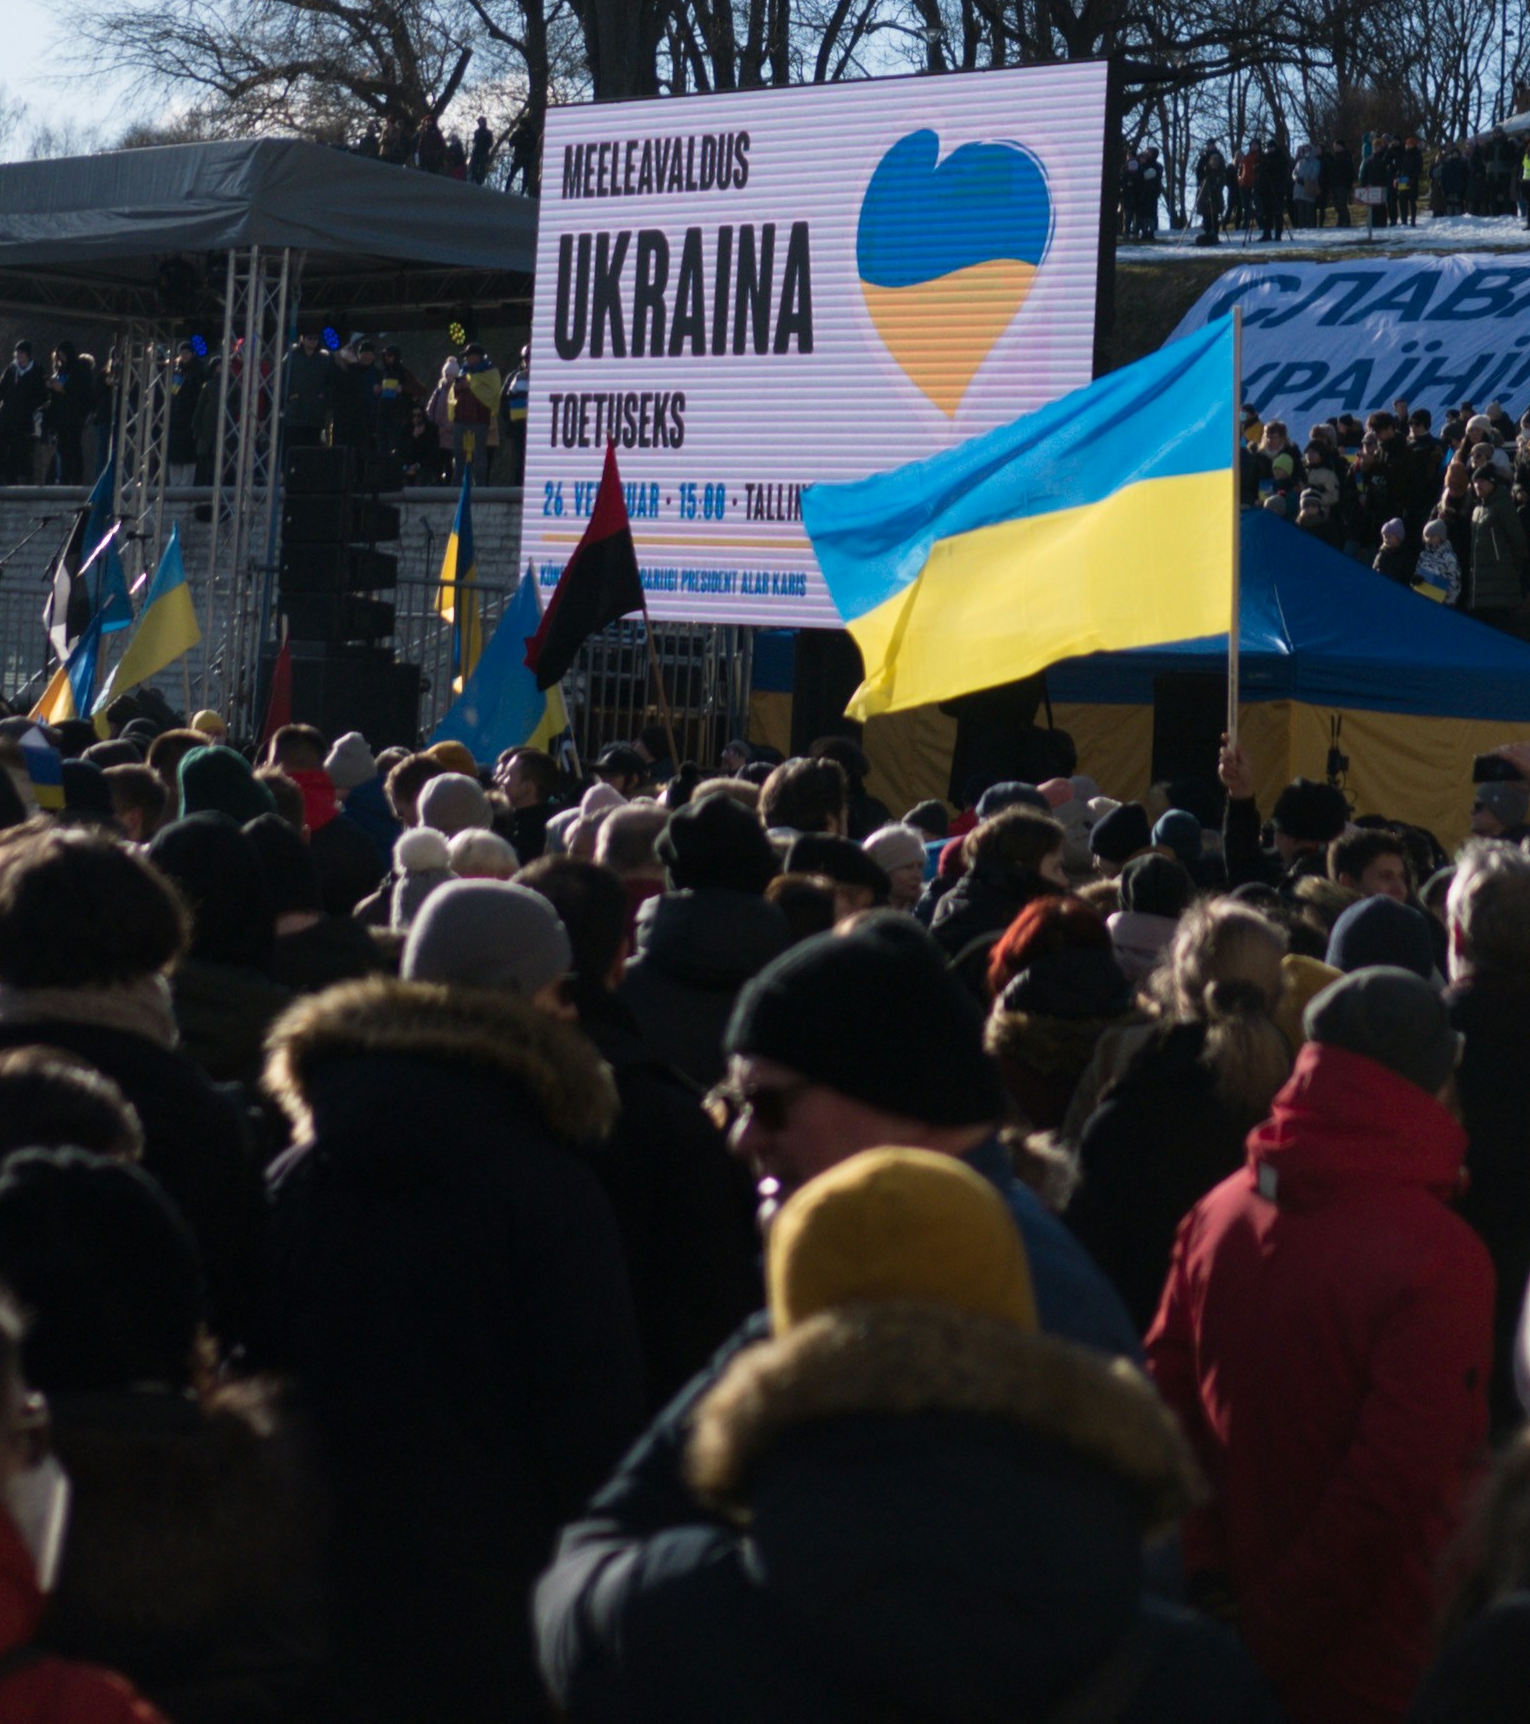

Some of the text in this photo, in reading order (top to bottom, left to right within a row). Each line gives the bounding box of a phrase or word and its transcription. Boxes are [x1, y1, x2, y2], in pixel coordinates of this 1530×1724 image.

[562, 131, 751, 199] MEELEAVALDUS
[553, 220, 814, 361] UKRAINA
[549, 389, 686, 449] TOETUSEKS
[543, 480, 568, 516] 26.
[572, 481, 660, 518] VEUAR
[679, 482, 726, 520] 15:00
[681, 569, 739, 593] PRESIDENT
[740, 571, 770, 595] ALAR
[772, 572, 807, 597] KARIS
